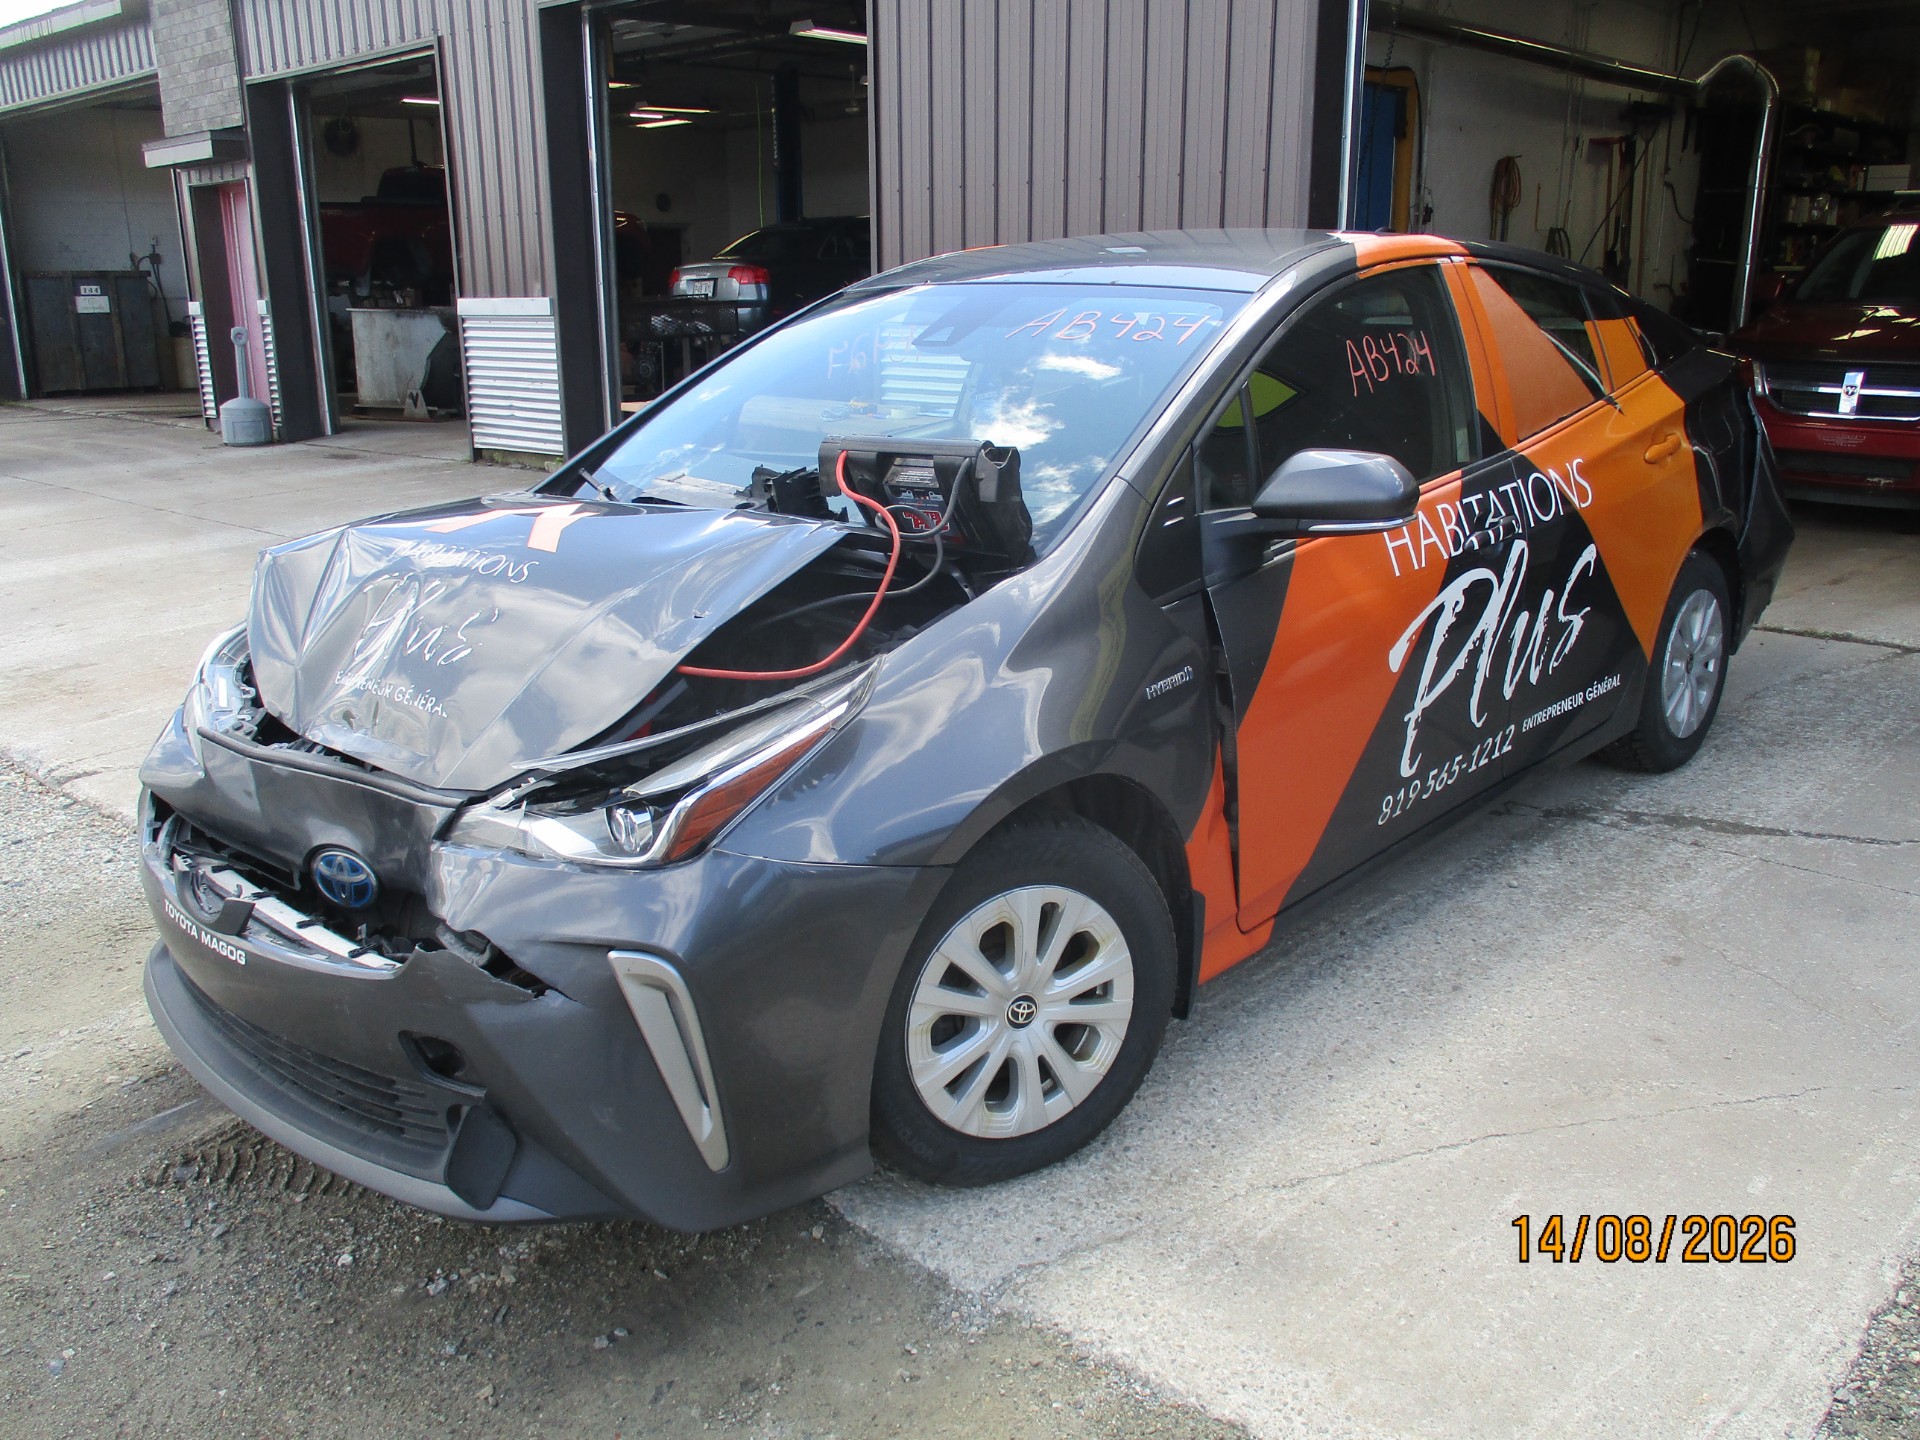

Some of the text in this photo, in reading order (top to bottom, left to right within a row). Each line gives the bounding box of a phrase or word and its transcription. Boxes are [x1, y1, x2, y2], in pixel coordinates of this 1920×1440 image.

[1005, 307, 1212, 346] AB424
[1346, 330, 1436, 397] AB424
[1383, 458, 1593, 577] HABITATIONS
[1146, 671, 1186, 700] HYBRID
[1388, 539, 1597, 778] Plus
[1521, 673, 1621, 733] ENTREPRENEUR GÉNÉRAL
[1378, 724, 1515, 826] 819 565-1212
[164, 898, 247, 966] TOYOTA MAGOG
